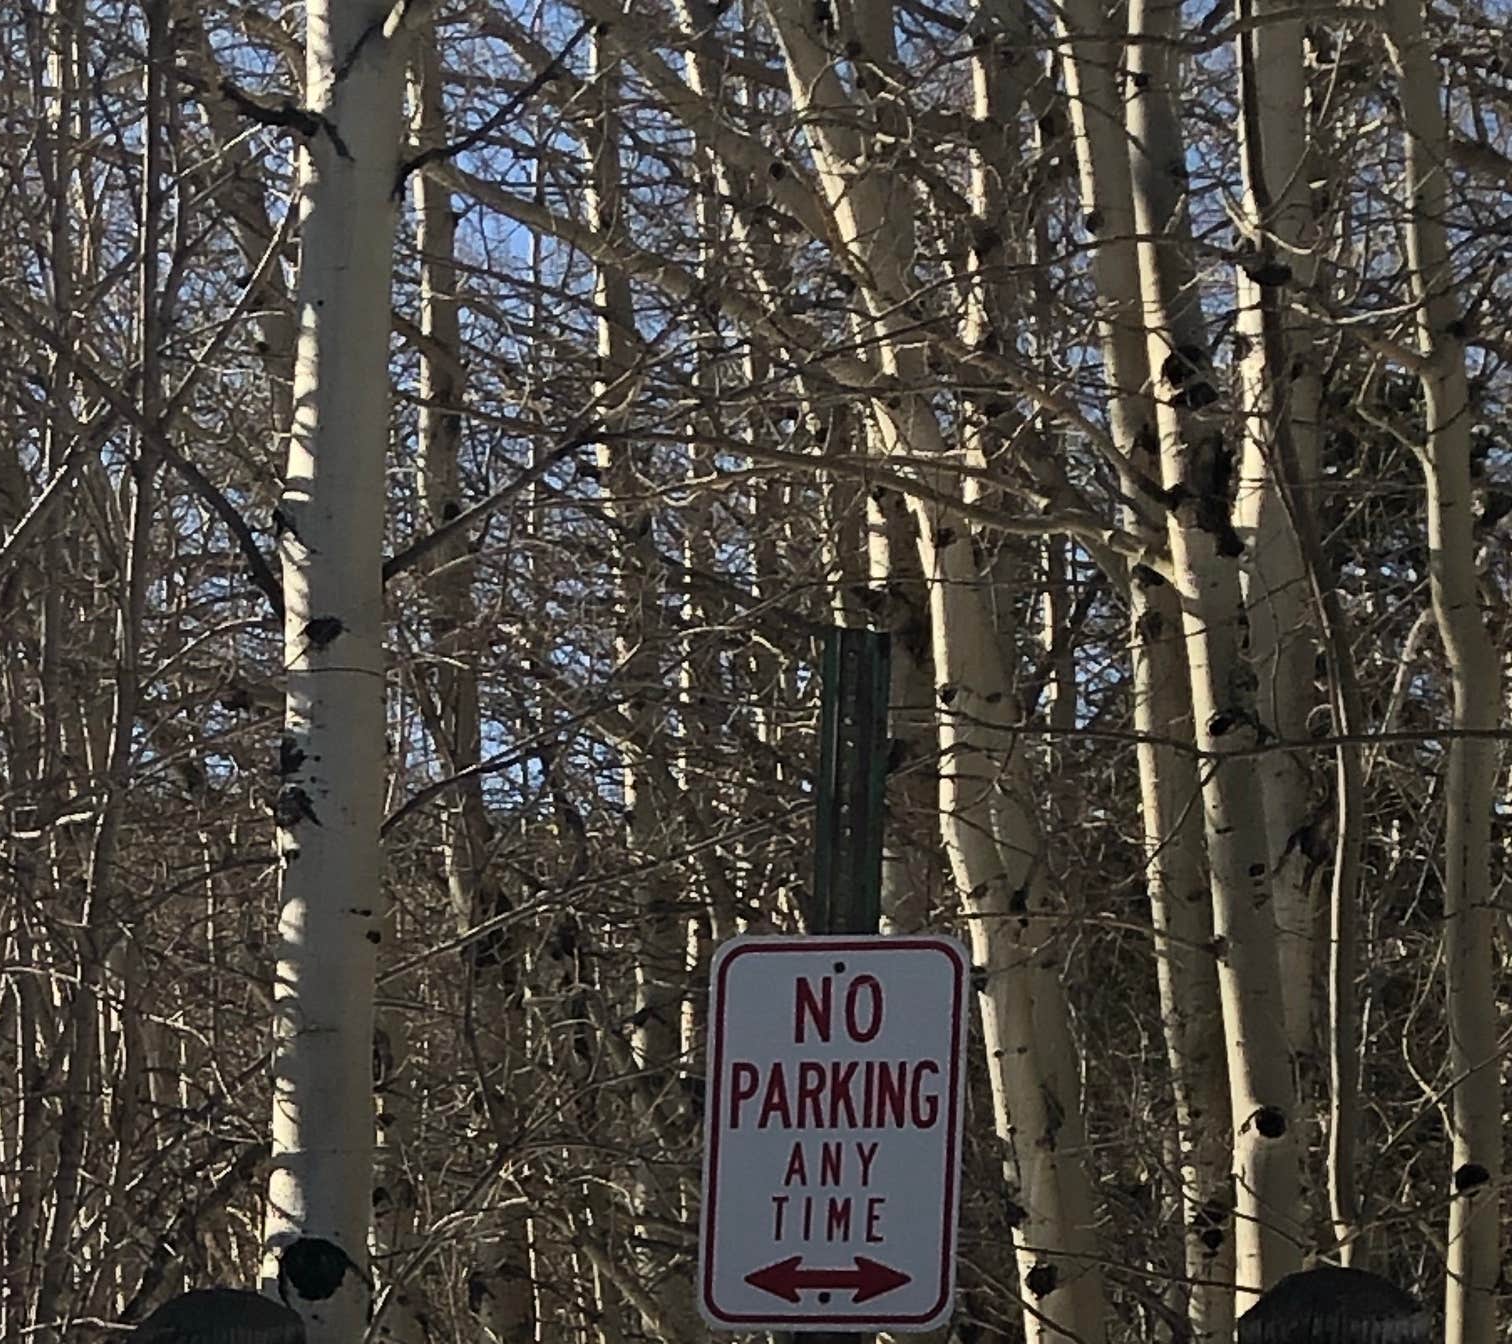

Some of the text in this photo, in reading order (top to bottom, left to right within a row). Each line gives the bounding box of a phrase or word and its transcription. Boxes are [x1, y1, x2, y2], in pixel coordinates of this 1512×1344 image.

[794, 974, 883, 1044] NO
[729, 1060, 939, 1130] PARKING
[784, 1142, 878, 1187] ANY
[772, 1197, 885, 1242] TIME
